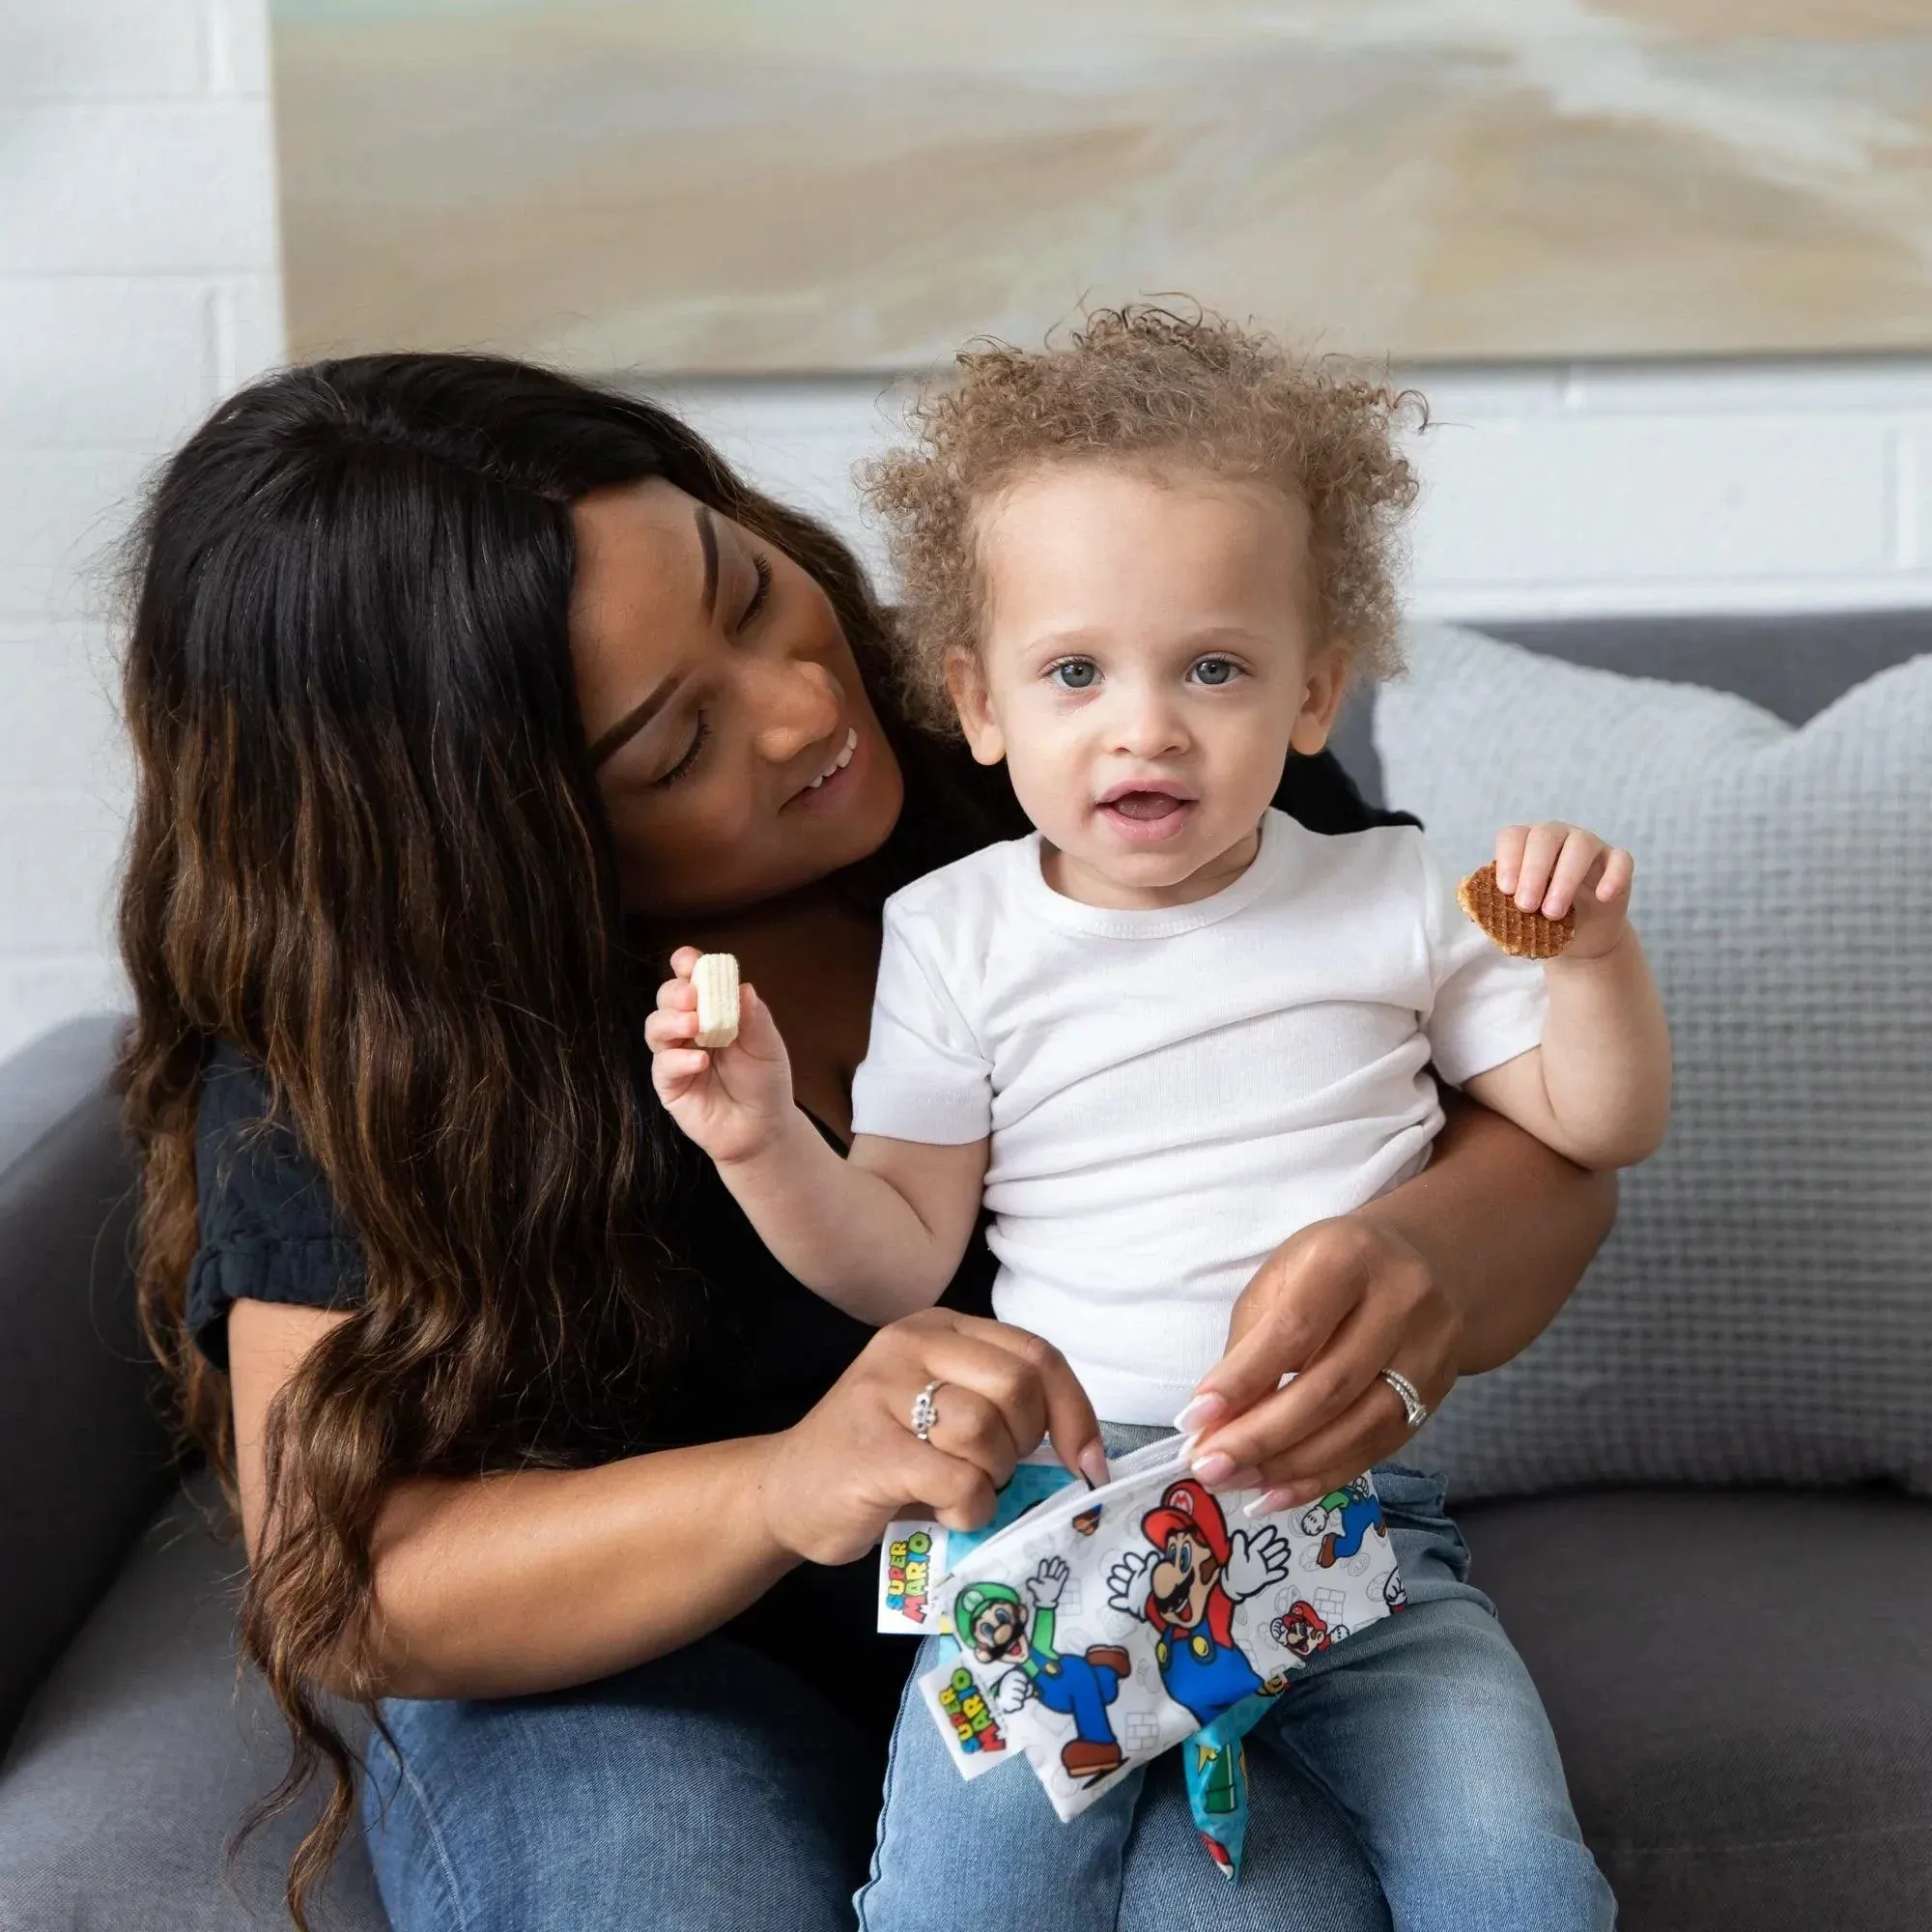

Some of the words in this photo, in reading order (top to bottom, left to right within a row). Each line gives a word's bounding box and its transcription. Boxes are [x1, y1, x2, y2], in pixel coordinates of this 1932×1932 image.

[1171, 1492, 1193, 1514] M
[886, 1541, 908, 1610] SUPER
[903, 1531, 932, 1624] MARIO
[939, 1685, 980, 1754] SUPER
[952, 1667, 1006, 1752] MARIO
